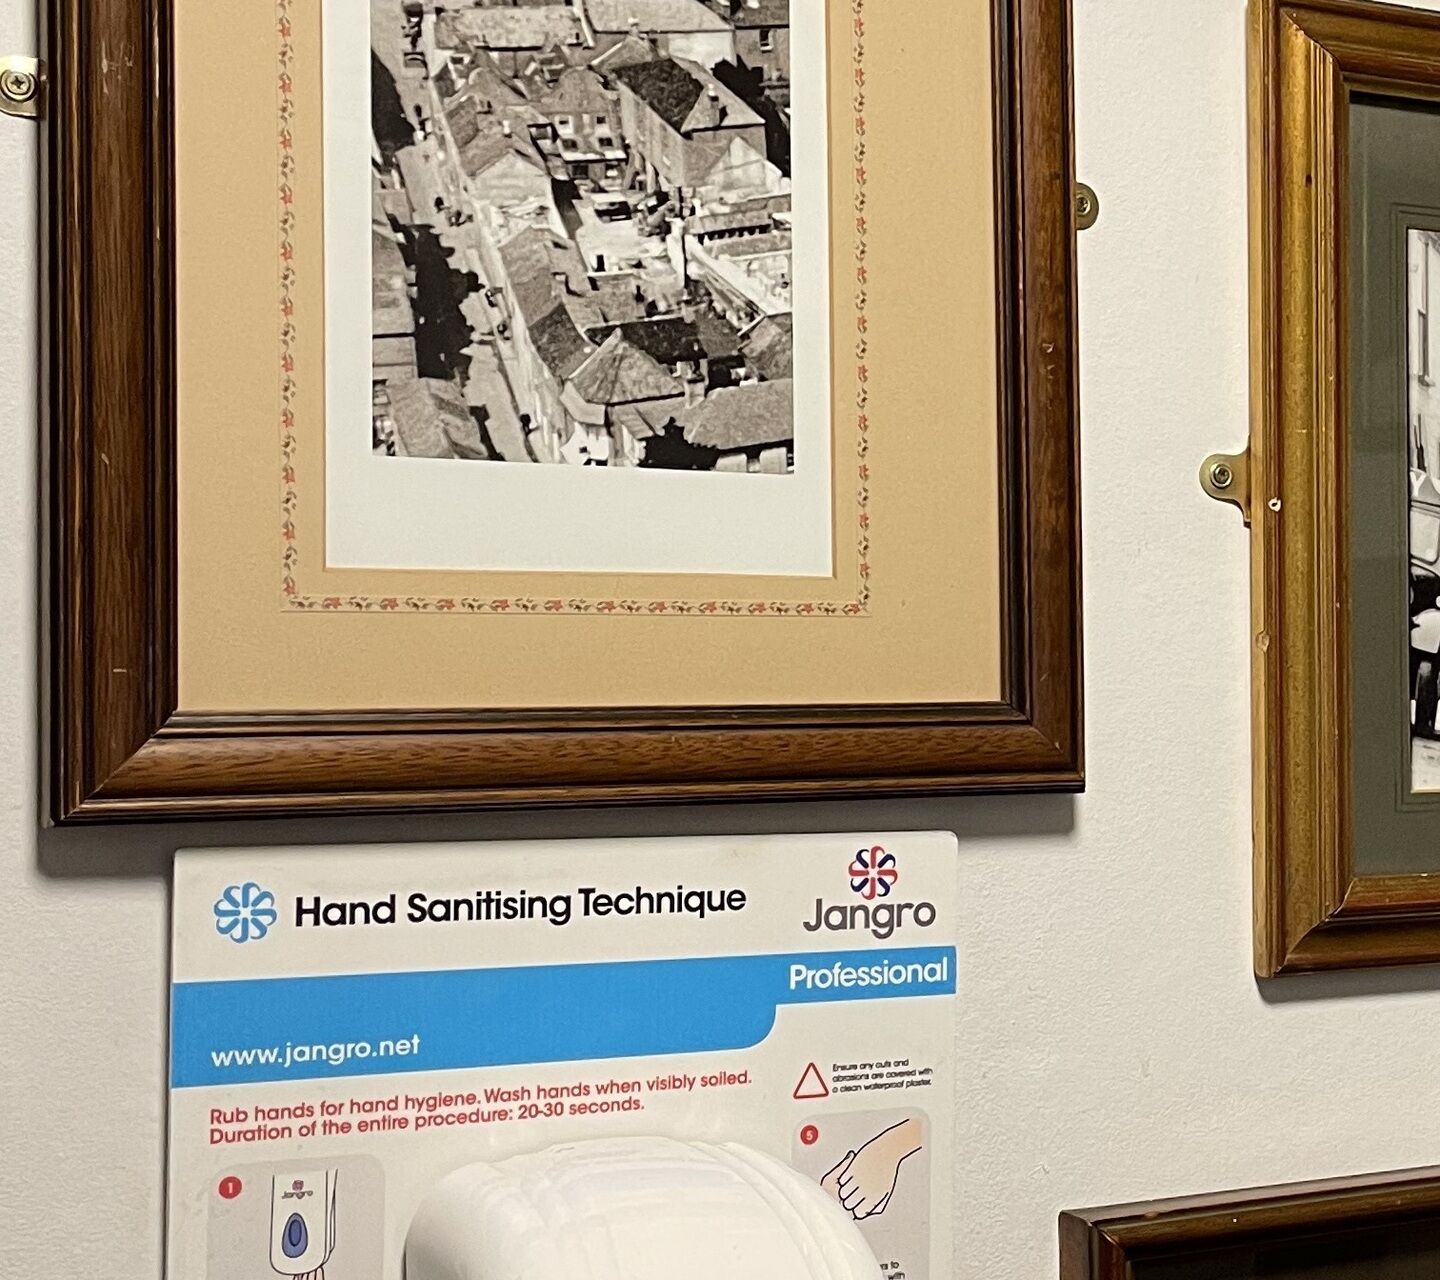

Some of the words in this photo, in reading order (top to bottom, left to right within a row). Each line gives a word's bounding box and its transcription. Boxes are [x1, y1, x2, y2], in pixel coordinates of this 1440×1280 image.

[295, 894, 396, 927] Hand
[407, 890, 572, 926] Sanitising
[578, 885, 747, 918] Technique
[803, 898, 936, 940] Jangro
[789, 956, 948, 991] Professional
[211, 1033, 421, 1068] www.jangro.net
[832, 1063, 858, 1072] Ensure
[859, 1062, 874, 1071] any
[875, 1060, 891, 1069] cuts
[893, 1058, 909, 1068] and
[832, 1073, 869, 1083] abrasions
[871, 1072, 884, 1080] are
[885, 1068, 916, 1079] covered
[918, 1067, 933, 1076] with
[832, 1086, 838, 1094] a
[840, 1083, 862, 1093] clean
[863, 1080, 905, 1091] waterproof
[210, 1106, 249, 1125] Rub
[254, 1102, 314, 1122] hands
[320, 1099, 345, 1117] for
[350, 1095, 399, 1114] hand
[404, 1091, 481, 1113] hygiene.
[484, 1085, 531, 1103] Wash
[536, 1081, 591, 1100] hands
[595, 1078, 641, 1096] when
[646, 1073, 697, 1092] visibly
[700, 1069, 752, 1088] soiled.
[210, 1124, 292, 1144] Duration
[299, 1120, 317, 1138] of
[322, 1119, 352, 1135] the
[357, 1115, 409, 1133] entire
[415, 1107, 513, 1131] procedure:
[517, 1102, 564, 1121] 20-30
[569, 1096, 645, 1115] seconds.
